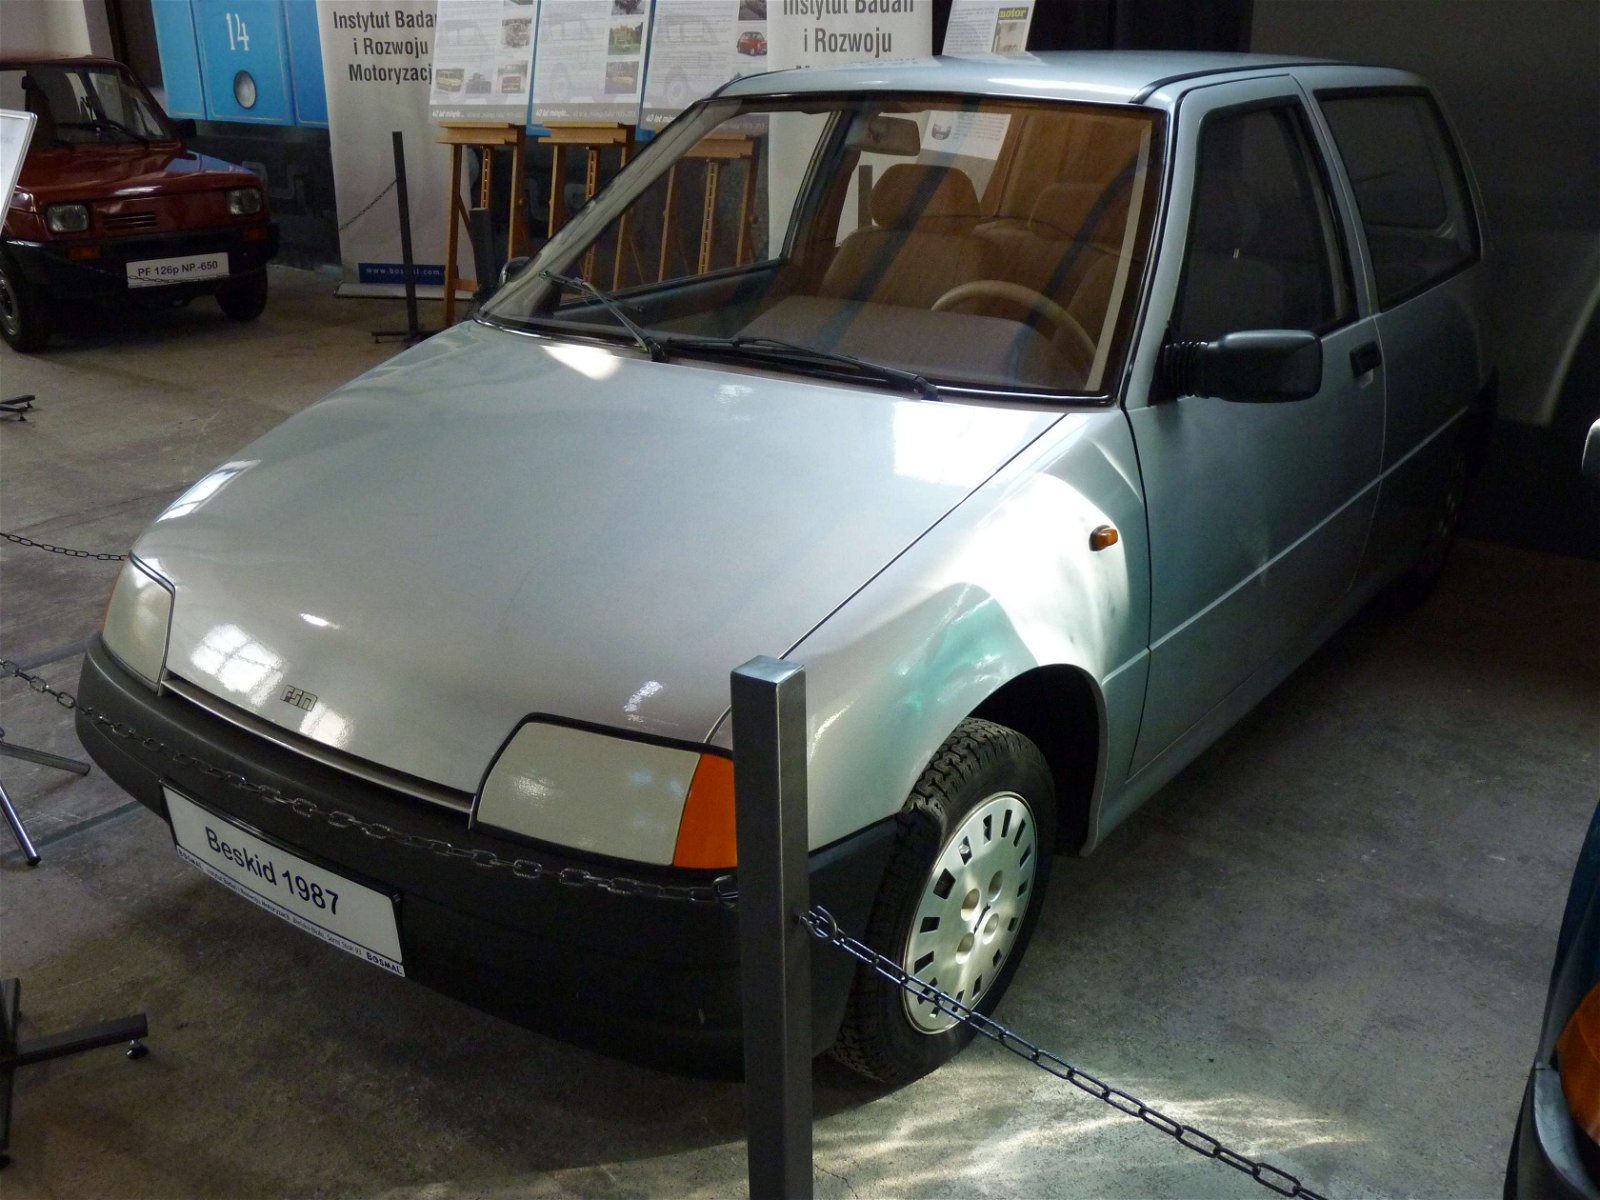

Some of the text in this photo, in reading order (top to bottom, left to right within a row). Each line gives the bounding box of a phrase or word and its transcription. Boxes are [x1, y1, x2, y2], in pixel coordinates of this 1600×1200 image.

[226, 12, 250, 51] 14
[333, 10, 437, 32] Instytut Bada
[353, 37, 429, 58] i Rozwoju
[804, 27, 892, 58] i Rozwoju
[348, 64, 432, 85] Motoryzacj
[137, 268, 151, 277] PF
[154, 265, 179, 276] 126p
[205, 826, 277, 886] Beskid
[282, 870, 338, 915] 1987
[366, 950, 402, 975] BOSMAL
